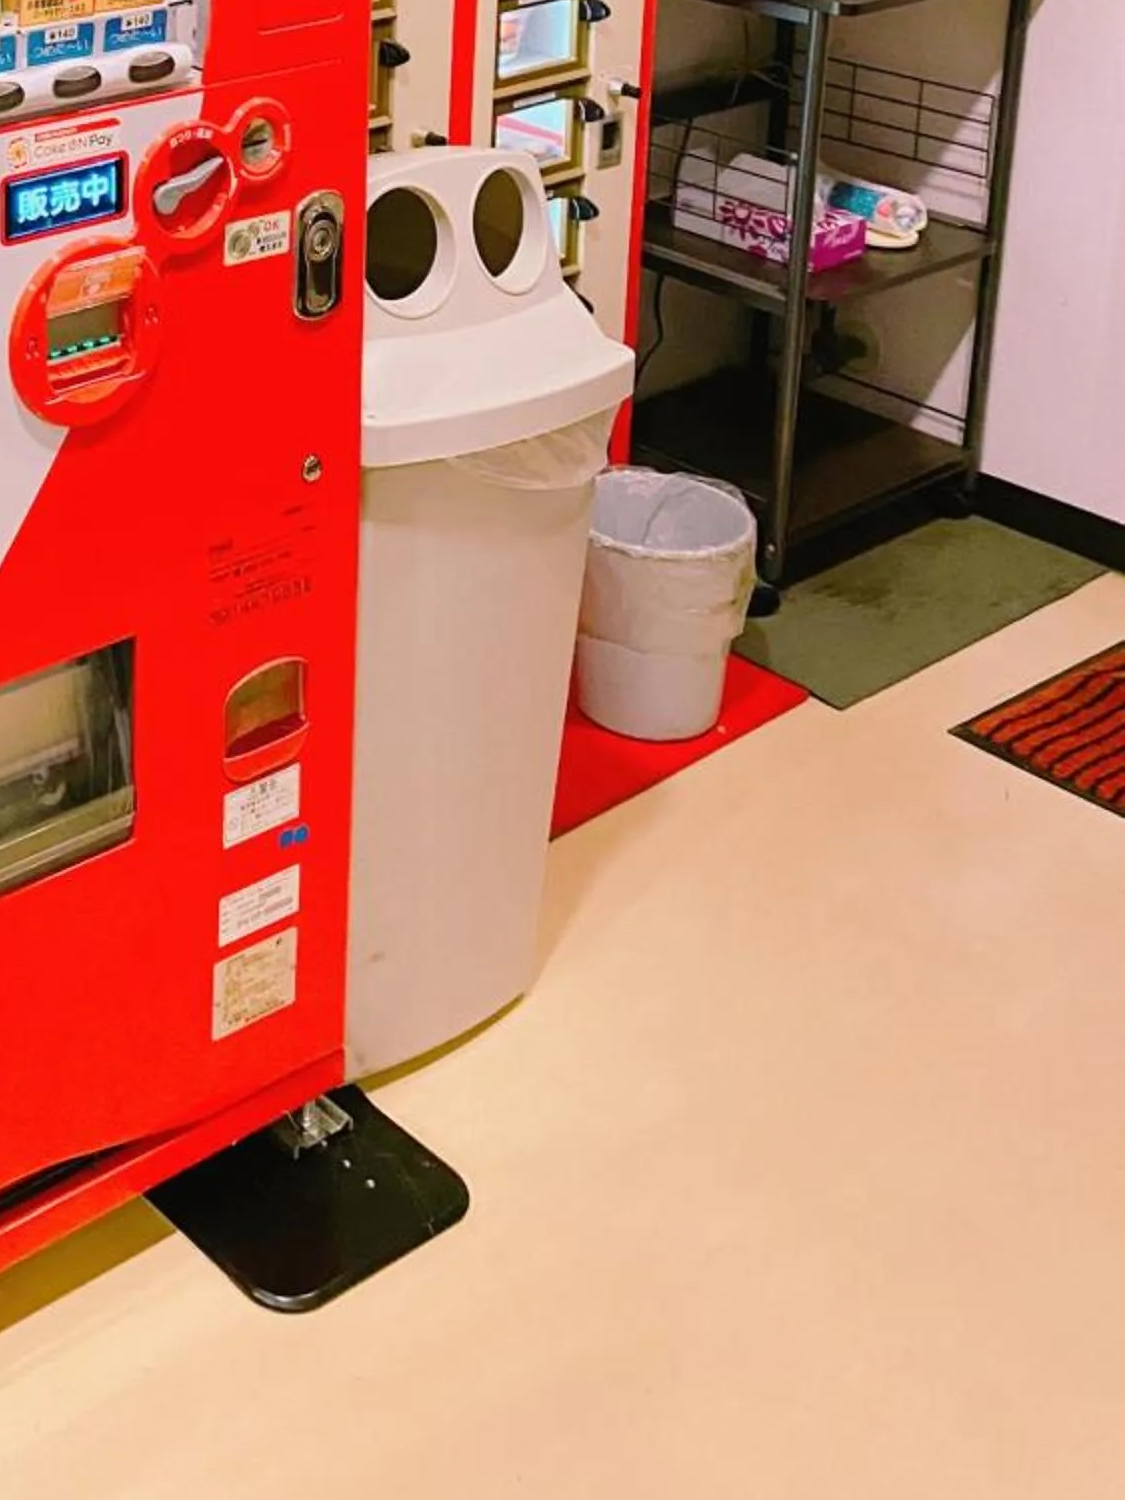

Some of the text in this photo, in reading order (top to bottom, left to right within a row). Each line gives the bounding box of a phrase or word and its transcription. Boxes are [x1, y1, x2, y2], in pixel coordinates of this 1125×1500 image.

[89, 133, 113, 148] Pay
[18, 173, 109, 223] 販売中
